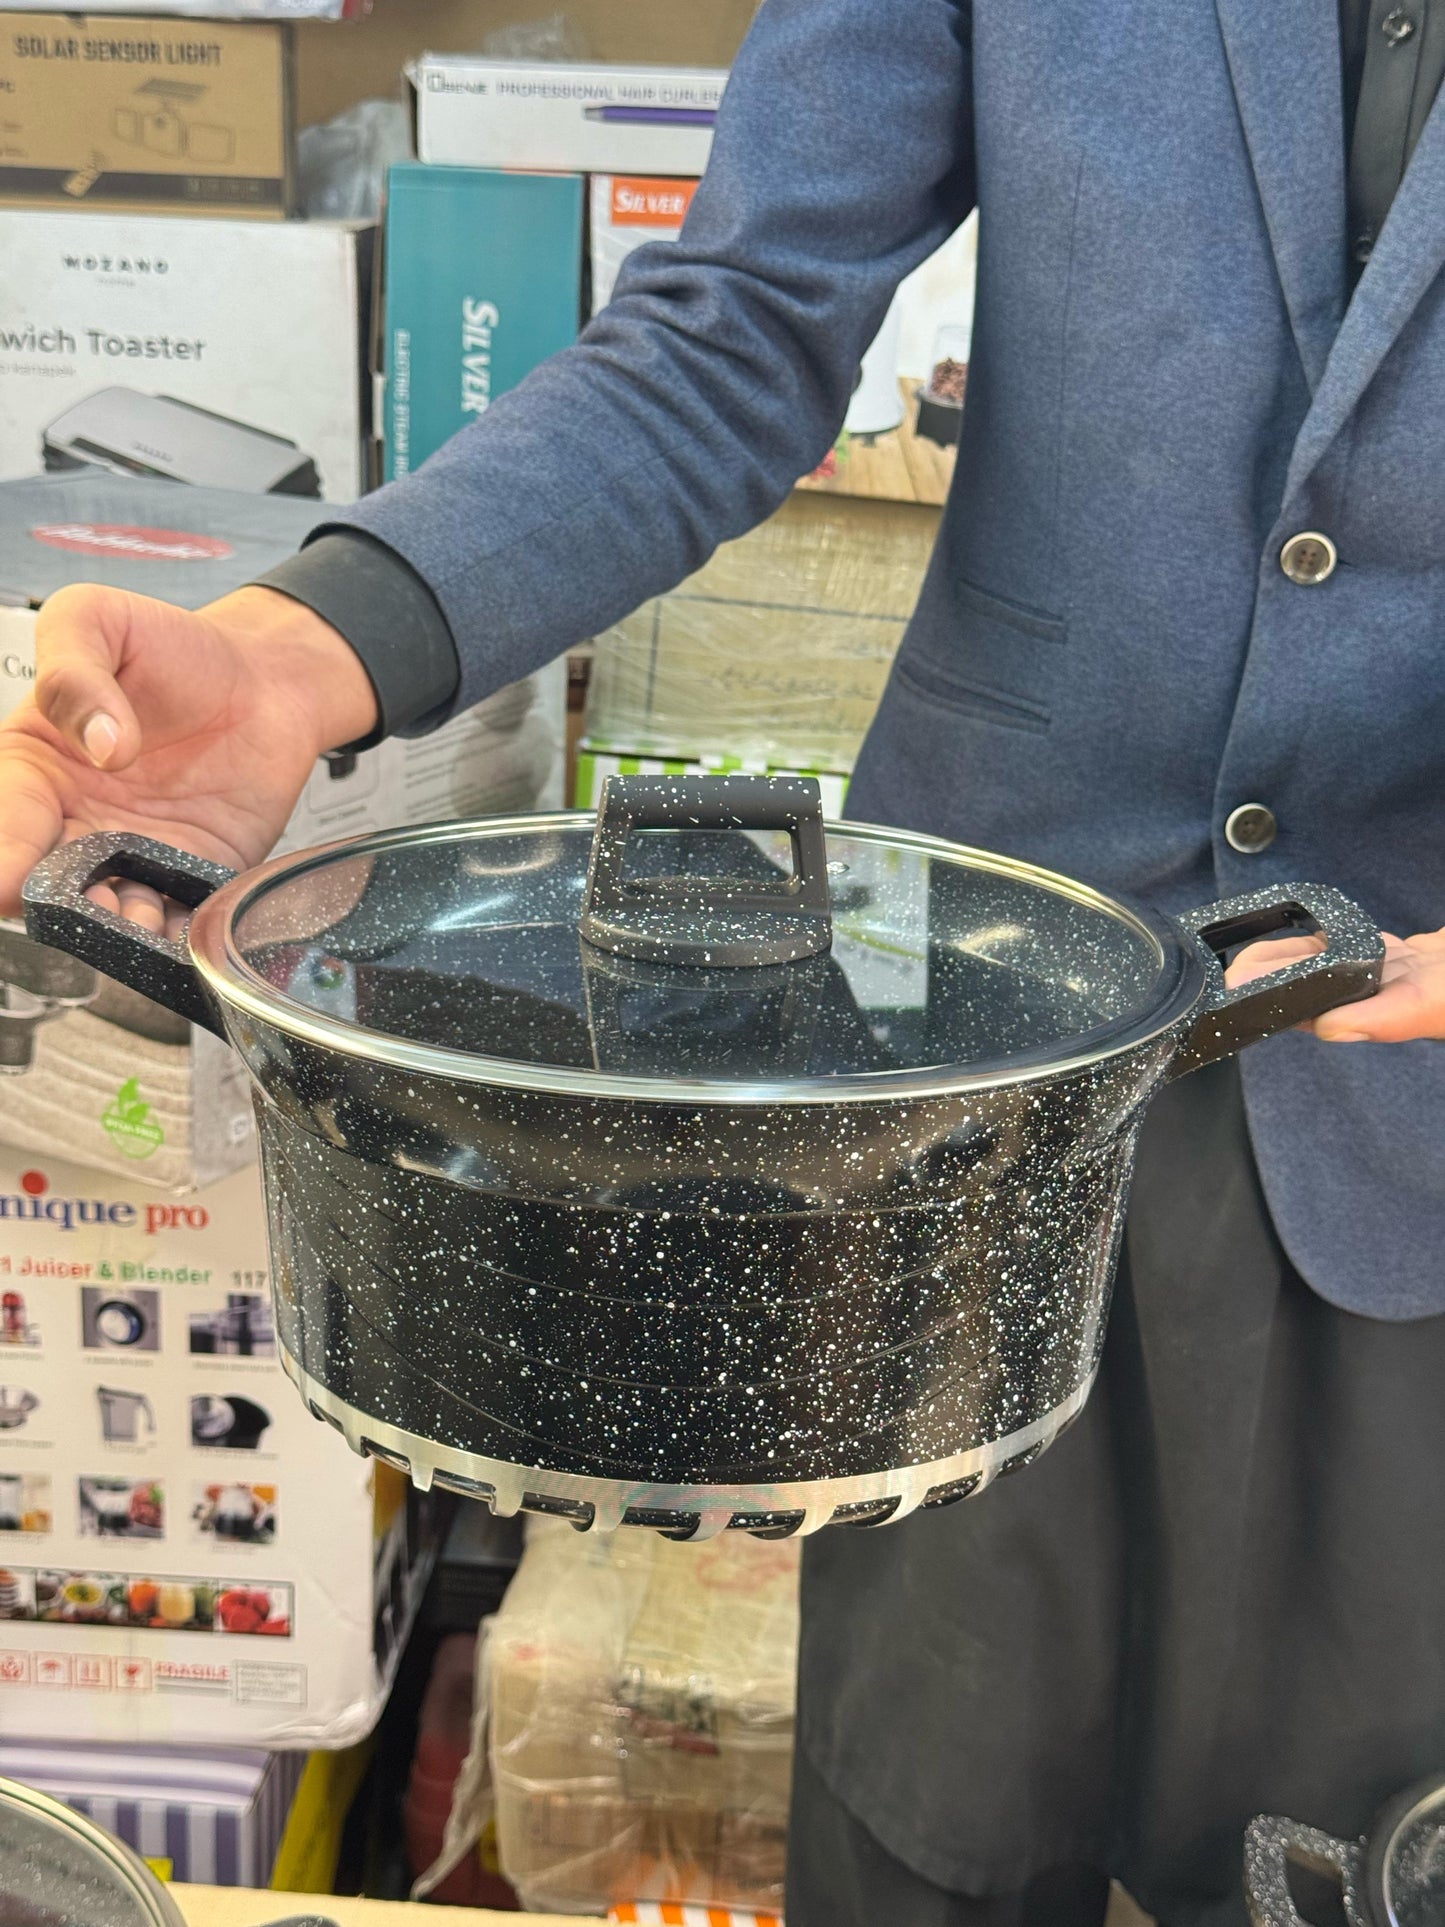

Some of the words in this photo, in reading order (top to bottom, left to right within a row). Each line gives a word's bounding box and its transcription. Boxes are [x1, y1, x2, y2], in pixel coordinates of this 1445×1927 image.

[14, 34, 79, 60] SOLAR
[83, 38, 162, 63] SENSOR
[165, 42, 222, 66] LIGHT
[614, 186, 685, 214] SILVER
[83, 325, 206, 360] Toaster
[461, 295, 500, 414] SILVER
[394, 329, 410, 400] ELECTRIC
[0, 1171, 136, 1232] nique
[144, 1202, 210, 1236] pro
[17, 1256, 93, 1279] Juicer
[95, 1260, 113, 1280] &
[118, 1260, 213, 1285] Blender
[154, 1660, 231, 1680] FRAGILE
